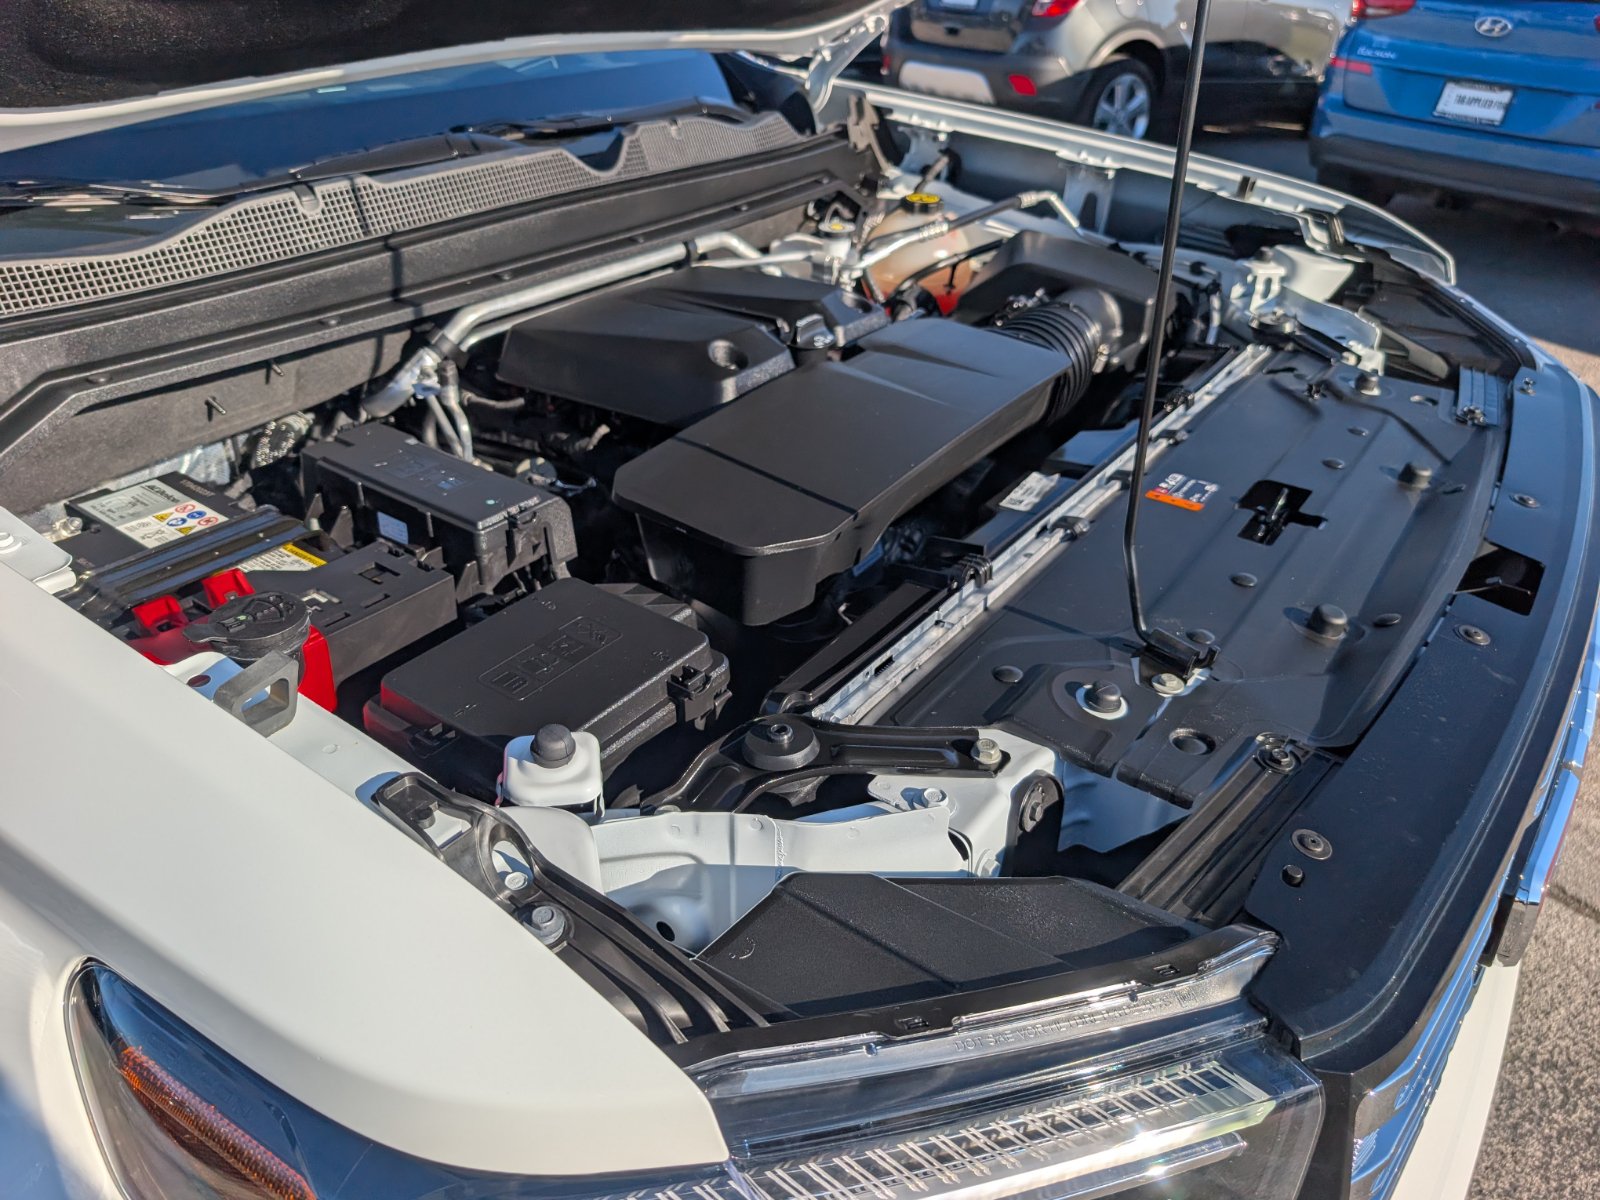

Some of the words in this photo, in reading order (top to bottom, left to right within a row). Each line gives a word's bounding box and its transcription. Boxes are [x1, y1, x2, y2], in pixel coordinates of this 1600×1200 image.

[954, 1036, 984, 1052] DOT
[986, 1029, 1015, 1047] SAE
[1016, 1023, 1047, 1040] VOR
